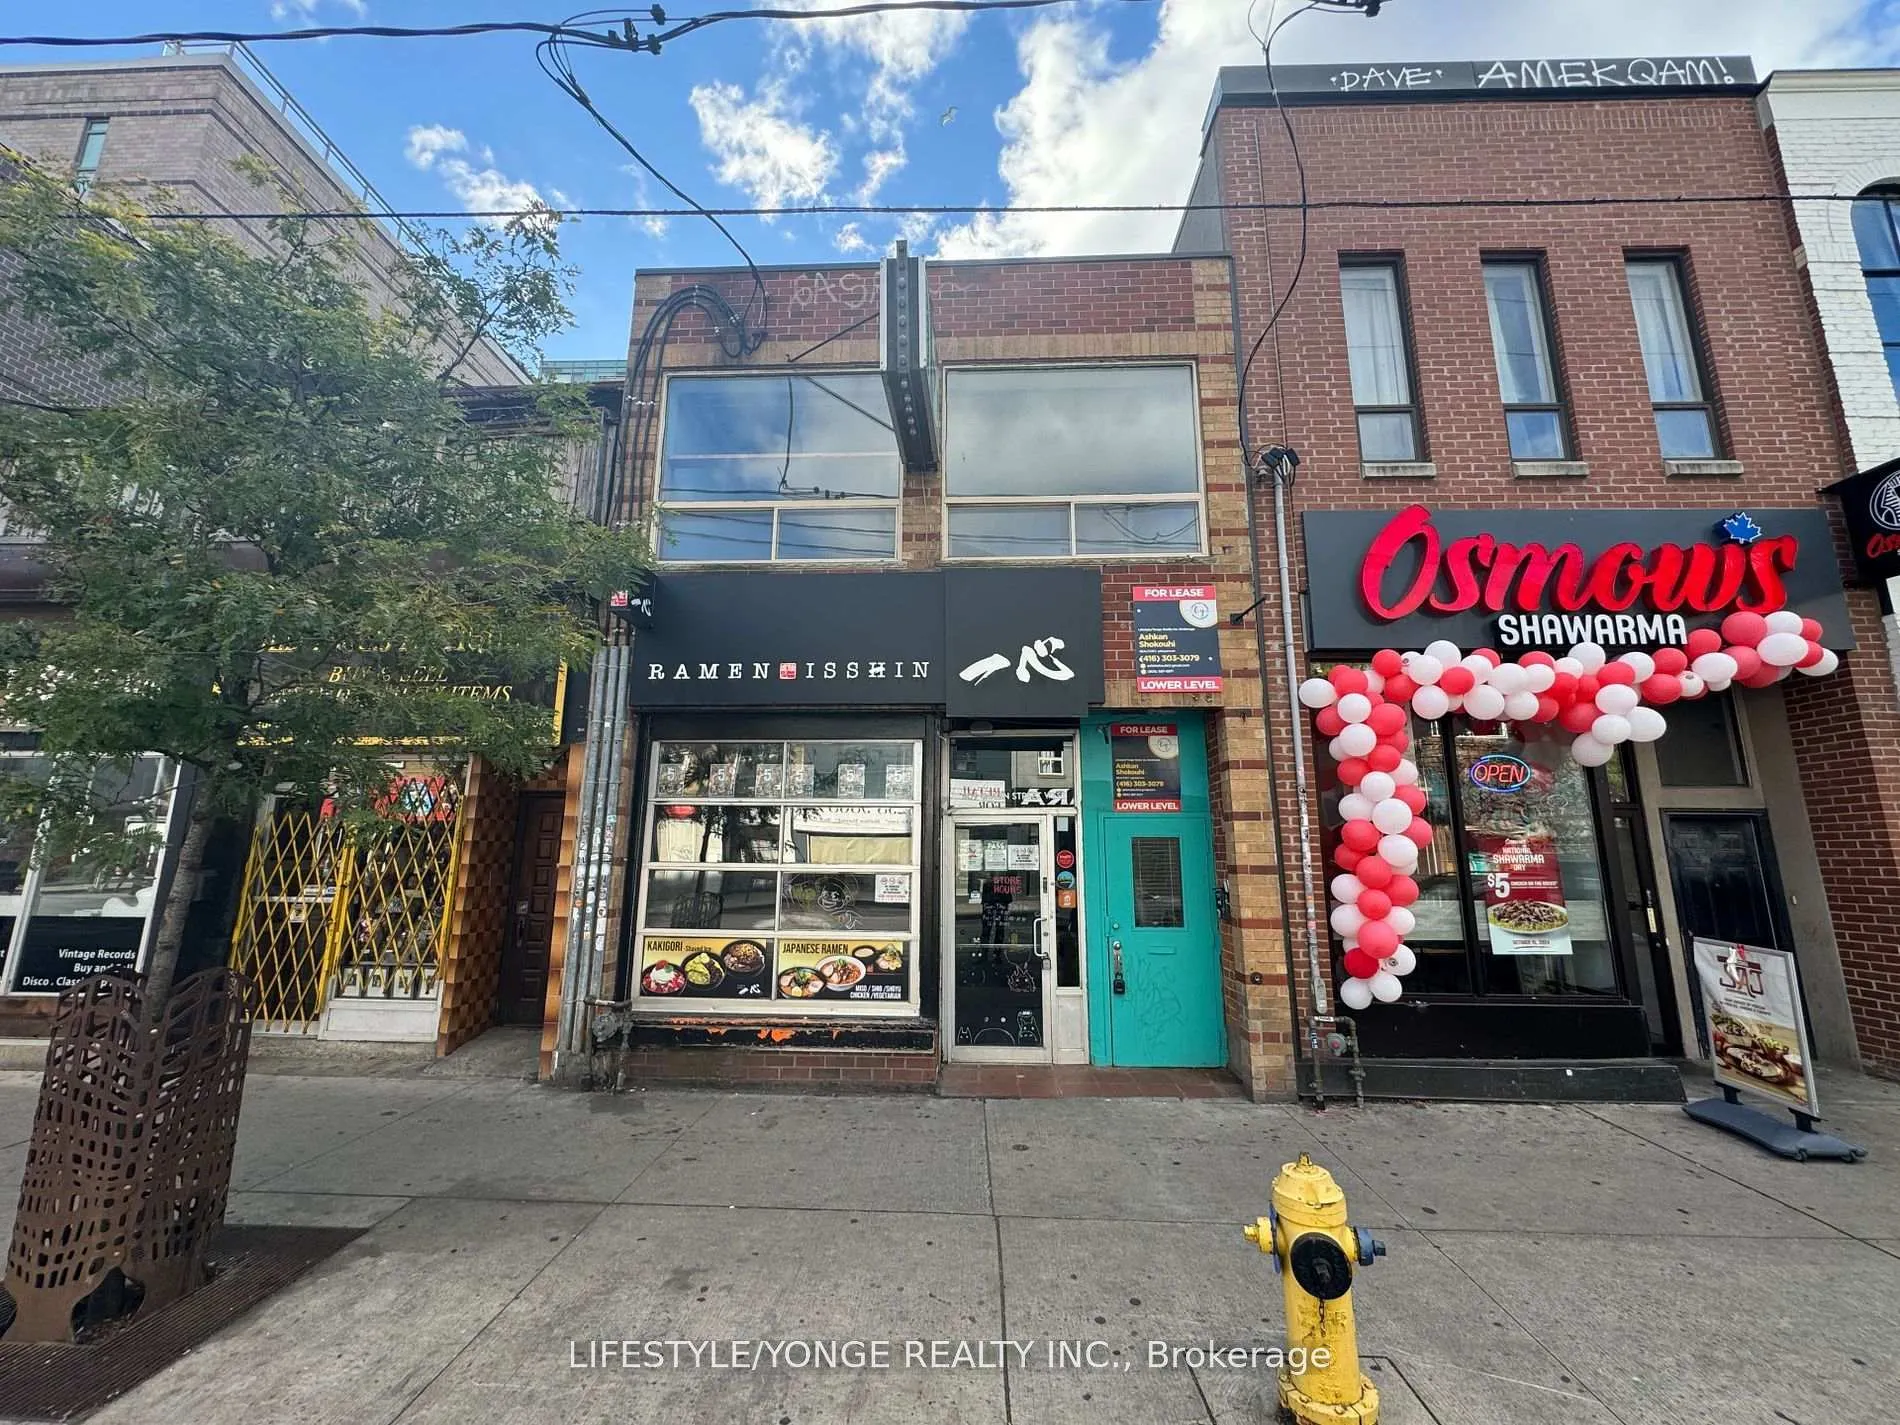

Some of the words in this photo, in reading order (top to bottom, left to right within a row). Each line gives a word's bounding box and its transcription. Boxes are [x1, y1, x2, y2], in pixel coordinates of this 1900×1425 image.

[1144, 588, 1168, 598] FOR
[1169, 588, 1205, 597] LEASE
[1498, 613, 1689, 646] SHAWARMA
[1138, 633, 1168, 641] Ashkan
[648, 662, 770, 680] RAMEN
[805, 661, 930, 679] ISSHIN
[1141, 681, 1182, 690] LOWER
[1183, 680, 1220, 690] LEVEL
[450, 685, 513, 702] ITEMS
[1120, 726, 1139, 734] FOR
[1140, 726, 1168, 734] LEASE
[1474, 764, 1525, 783] OPEN
[1116, 802, 1150, 810] LOWER
[1150, 802, 1179, 810] LEVEL
[1492, 854, 1544, 864] SHAWARMA
[1487, 872, 1510, 898] $5
[647, 940, 683, 951] KAKIGORI
[782, 943, 820, 954] JAPANESE
[821, 943, 849, 954] RAMEN
[58, 948, 95, 960] Vintage
[97, 949, 136, 959] Records
[73, 963, 92, 974] Buy
[22, 976, 49, 986] Disco
